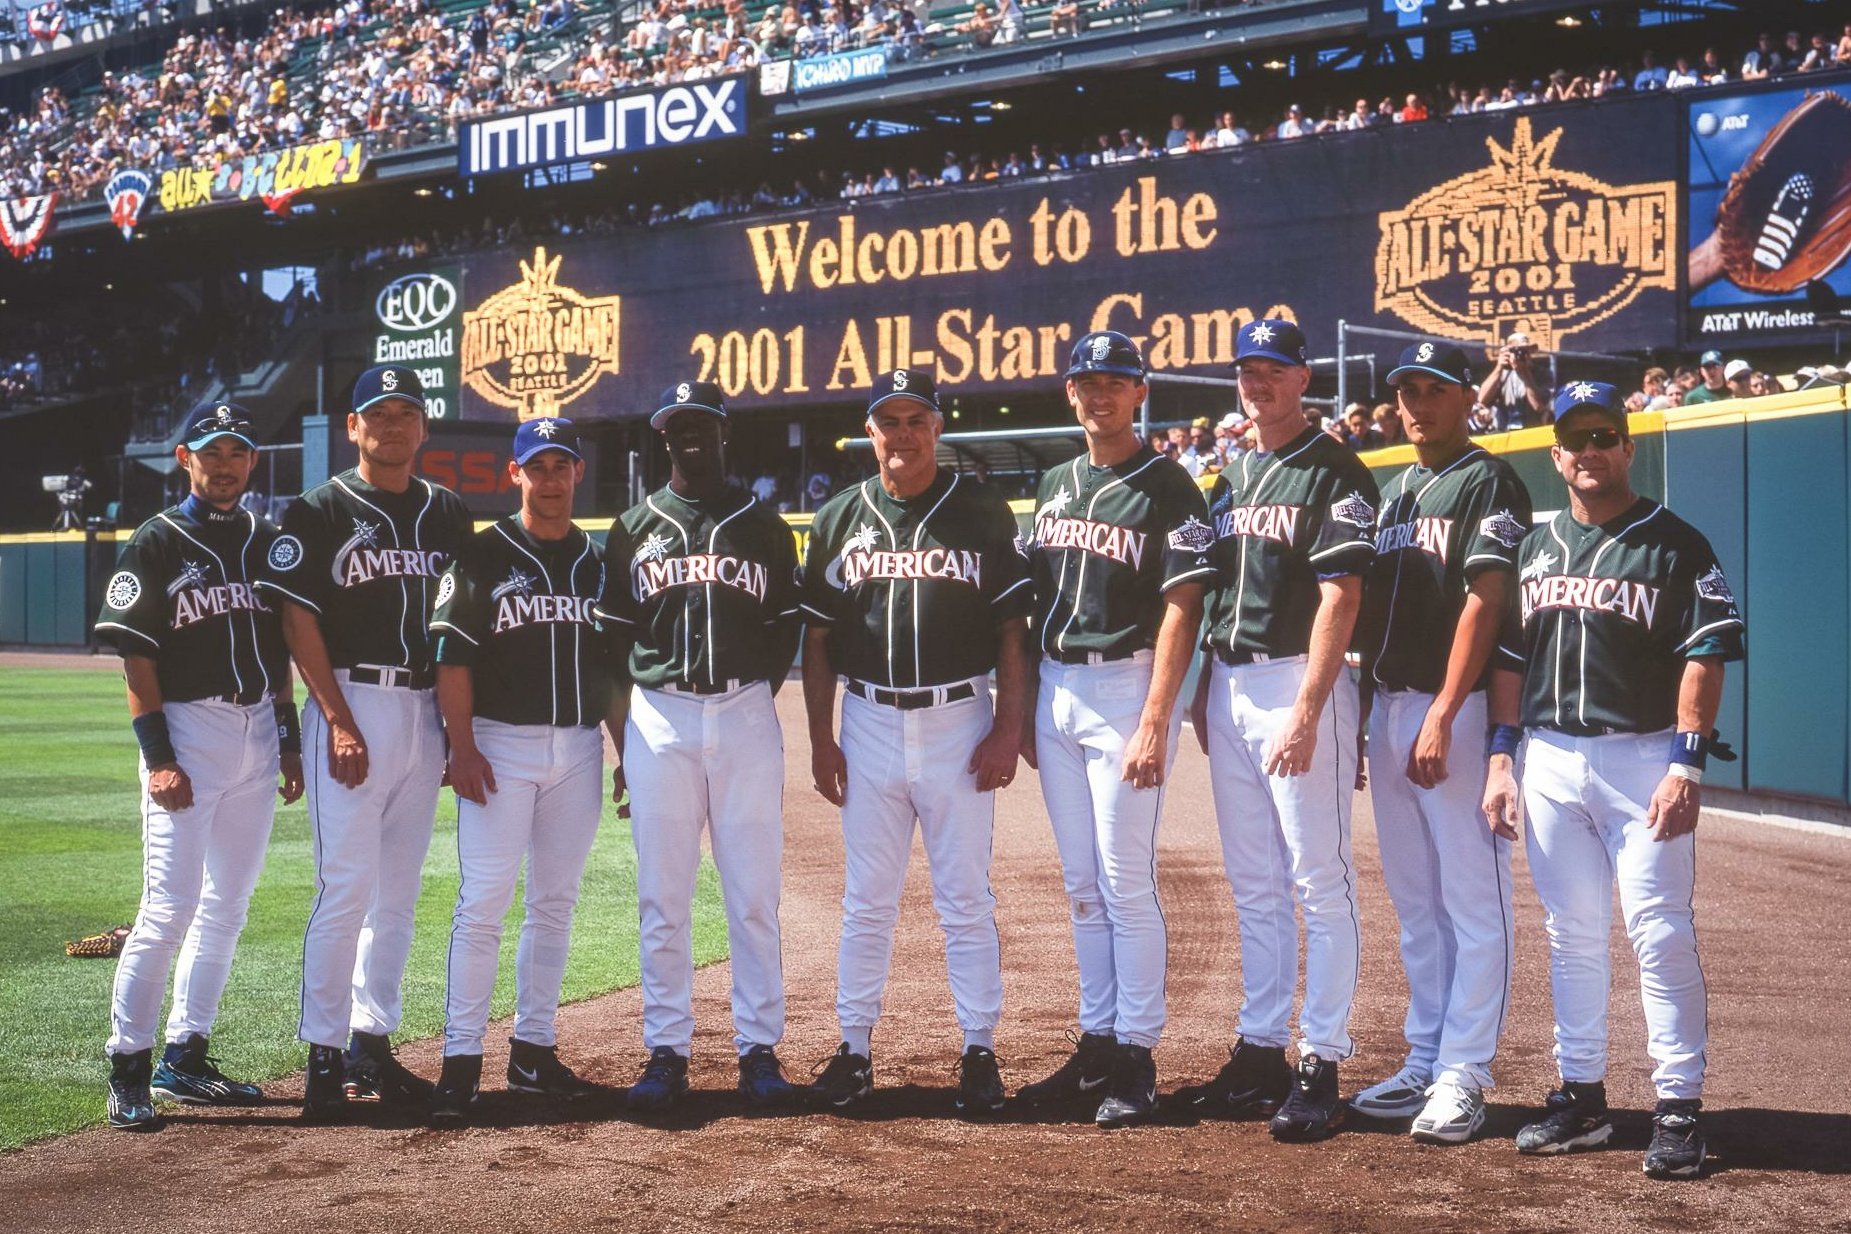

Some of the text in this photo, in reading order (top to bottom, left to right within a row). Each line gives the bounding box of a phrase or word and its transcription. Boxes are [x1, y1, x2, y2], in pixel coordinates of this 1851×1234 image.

[853, 53, 885, 78] MVP
[1721, 114, 1750, 131] AT&T
[746, 176, 1218, 295] Welcome to the
[1554, 195, 1665, 272] GAME
[1469, 264, 1576, 294] 2001
[386, 279, 448, 328] EQC
[1468, 293, 1576, 315] SEATTLE
[1701, 312, 1742, 333] AT&T
[374, 328, 454, 363] Emerald
[554, 305, 614, 360] GAME
[510, 353, 568, 375] 2001
[690, 325, 810, 397] 2001
[510, 376, 568, 391] SEATTLE
[1215, 504, 1301, 548] MERICAN
[1375, 518, 1454, 566] MERICAN
[345, 549, 449, 588] AMERIC
[638, 554, 768, 604] AMERICAN
[844, 549, 981, 593] AMERICAN
[495, 595, 600, 634] AMERIC
[1521, 575, 1660, 631] AMERICAN
[1685, 732, 1700, 750] 11
